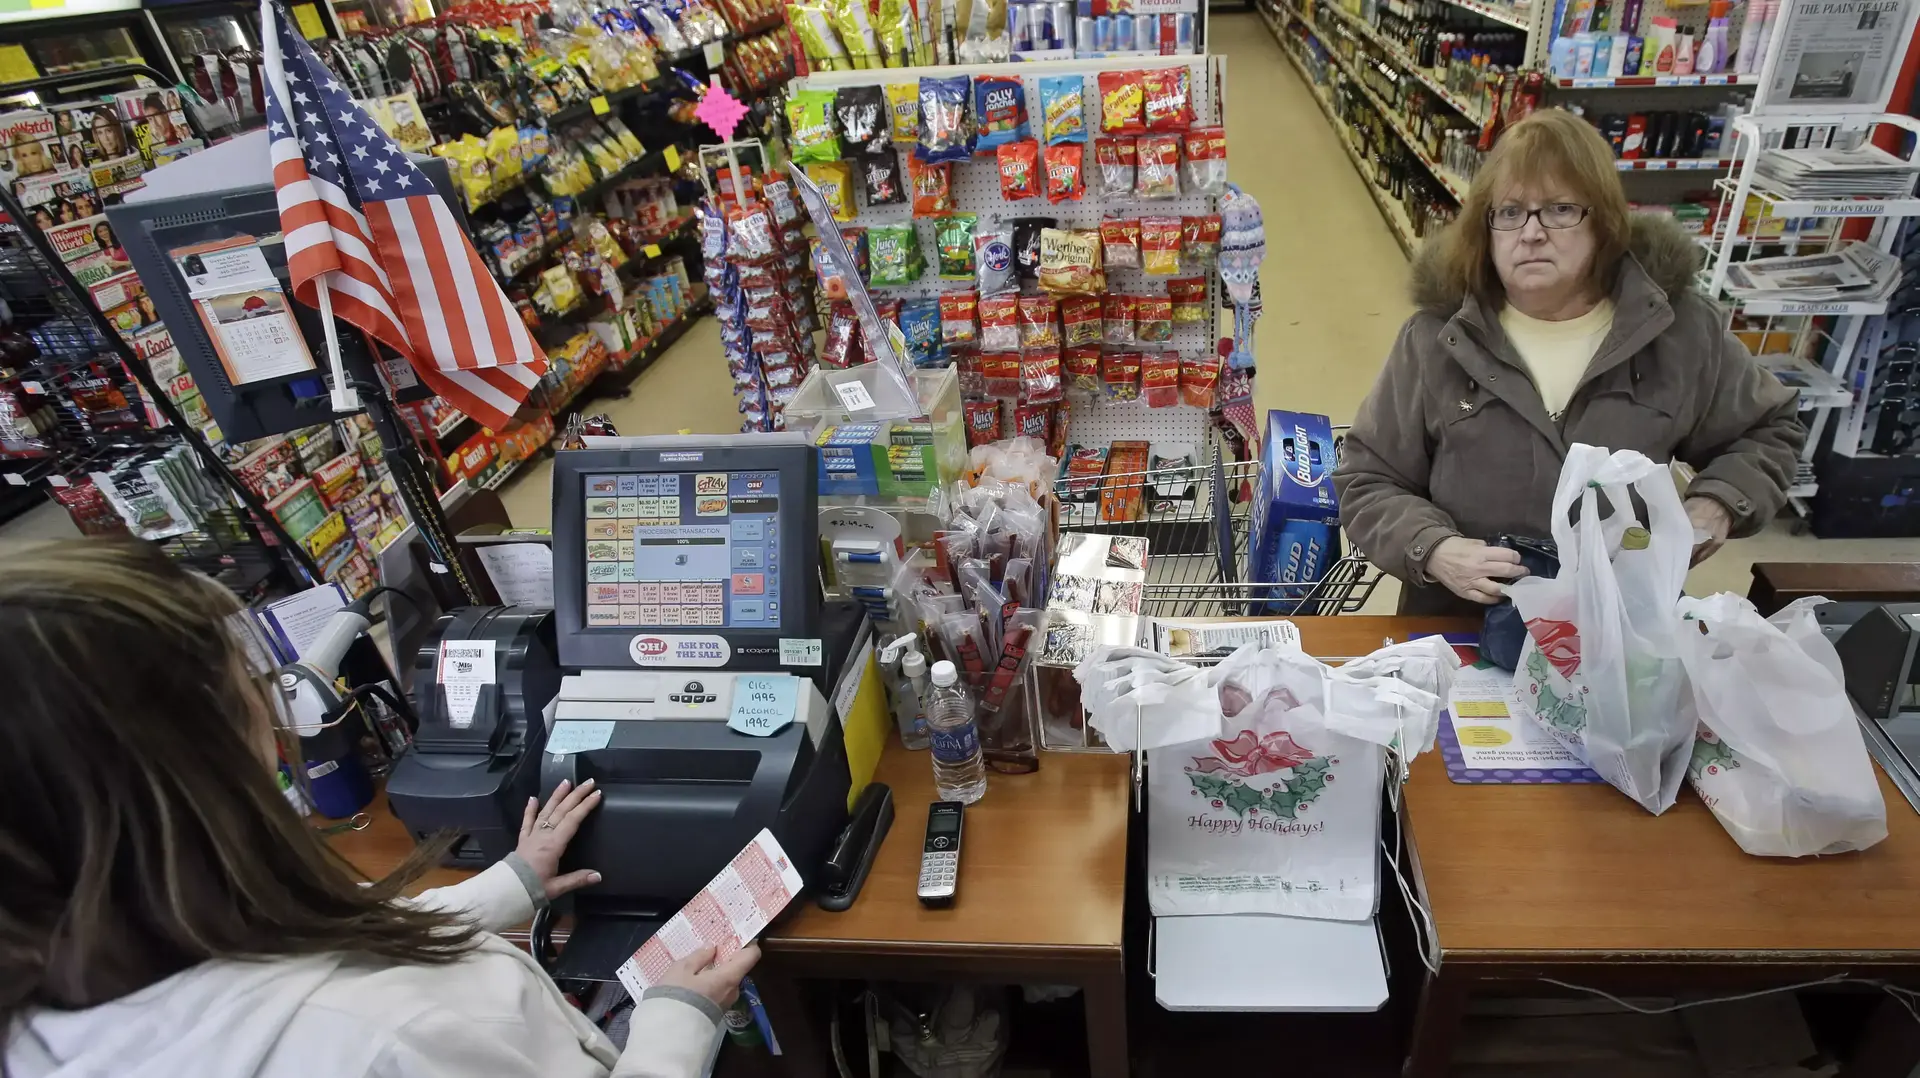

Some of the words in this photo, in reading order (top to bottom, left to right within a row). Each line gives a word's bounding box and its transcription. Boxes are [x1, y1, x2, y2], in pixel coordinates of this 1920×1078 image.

[1800, 4, 1820, 14] THE
[1823, 3, 1856, 14] PLAIN
[1857, 2, 1898, 13] DEALER
[985, 88, 1012, 104] JOLLY
[1852, 205, 1884, 213] DEALER
[56, 236, 84, 252] World
[1056, 251, 1092, 264] Original
[146, 332, 172, 357] Good
[972, 412, 994, 426] Juicy
[1022, 414, 1044, 432] Juicy
[1294, 424, 1310, 456] LIGHT
[1296, 453, 1312, 483] BUD
[1284, 542, 1302, 583] BUD
[637, 642, 666, 652] OH!
[752, 692, 776, 702] 1995
[738, 706, 783, 716] ALCOHOL
[746, 718, 770, 728] 1992
[1187, 814, 1243, 838] Happy
[1248, 815, 1324, 838] Holidays!
